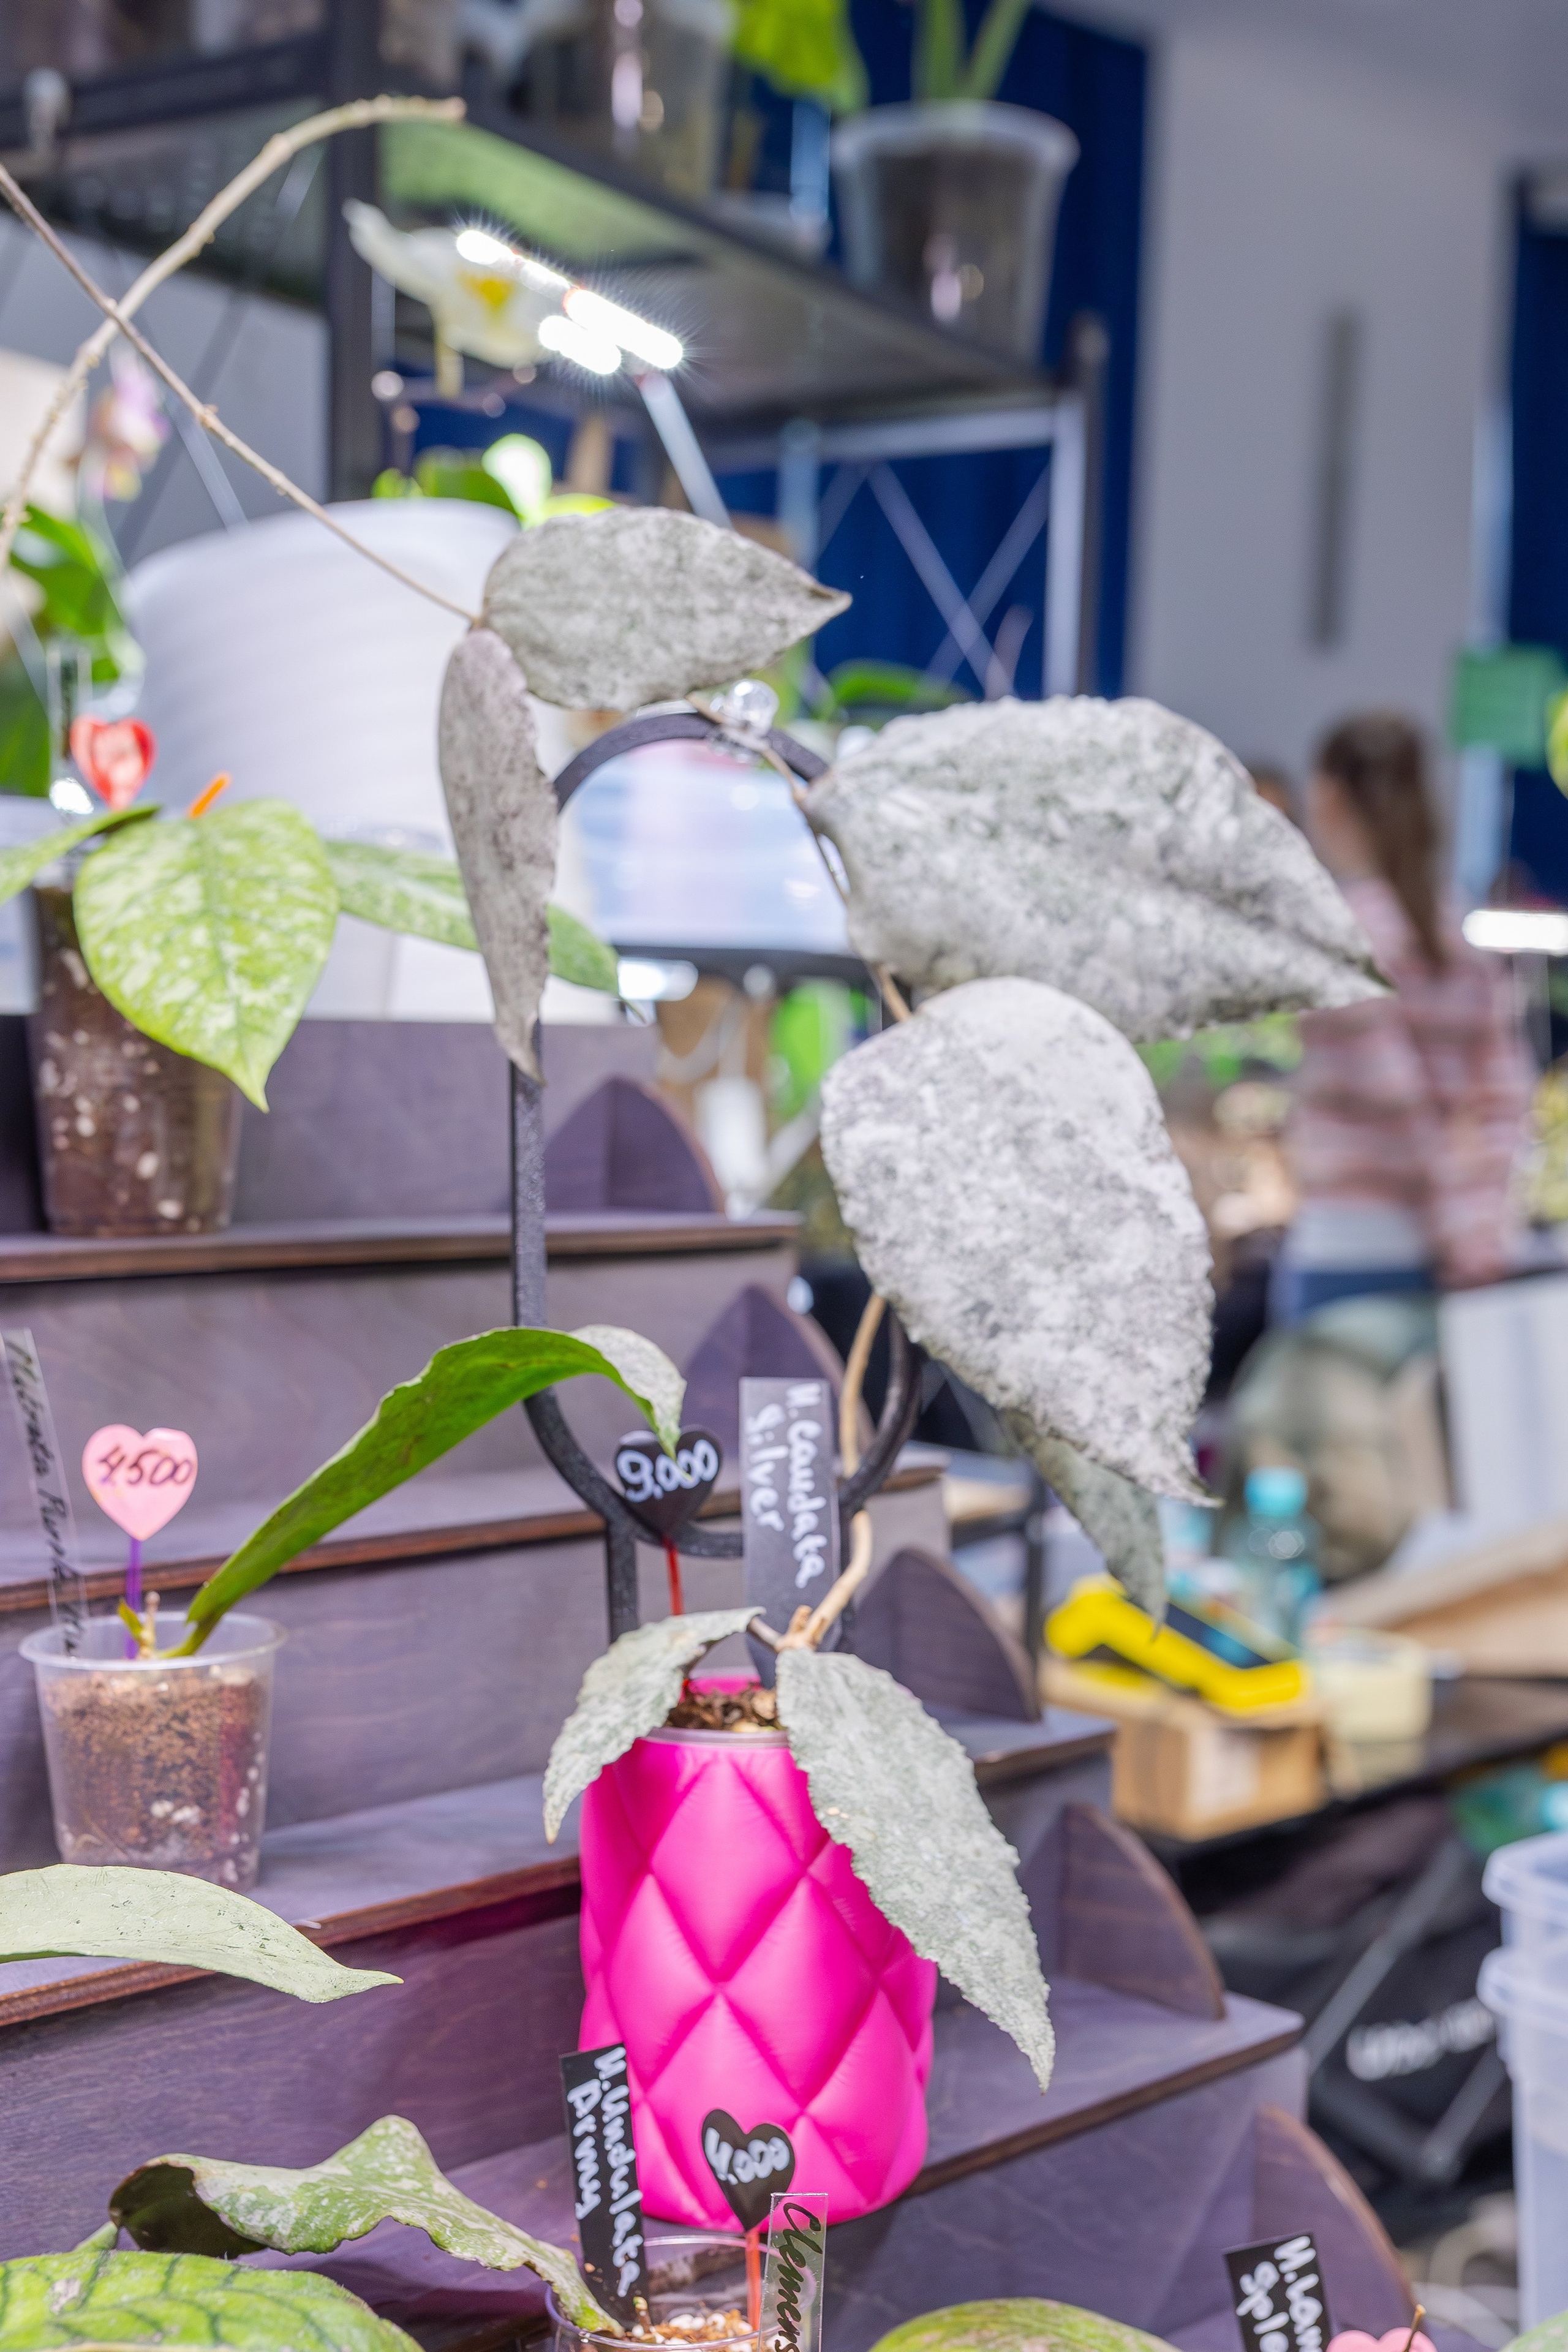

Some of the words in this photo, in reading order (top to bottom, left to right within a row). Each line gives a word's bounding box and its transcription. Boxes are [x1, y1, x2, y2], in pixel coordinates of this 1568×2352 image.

[99, 1446, 192, 1485] 4500
[745, 1403, 789, 1531] Silver
[567, 2079, 601, 2220] Army
